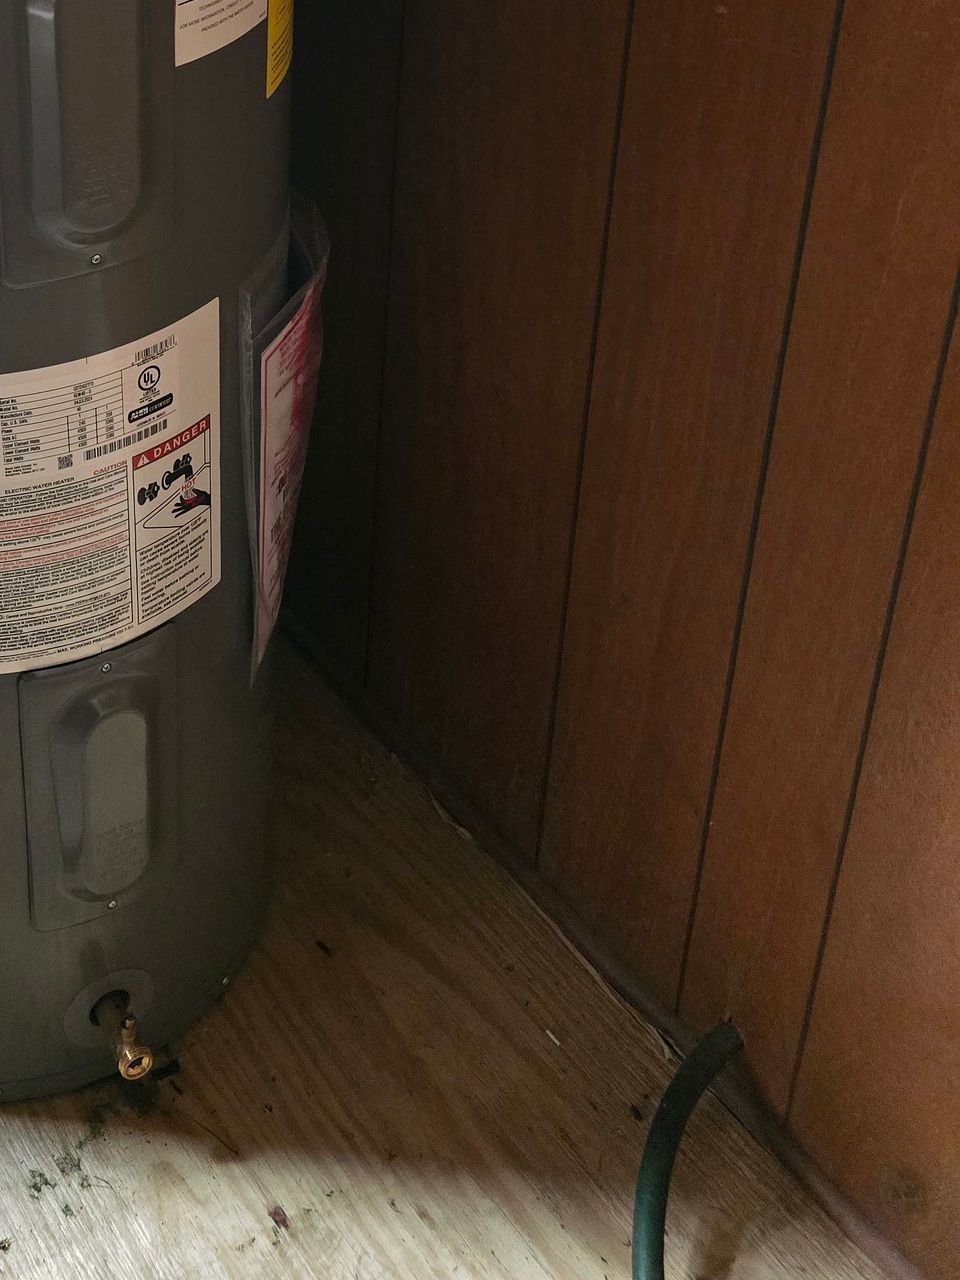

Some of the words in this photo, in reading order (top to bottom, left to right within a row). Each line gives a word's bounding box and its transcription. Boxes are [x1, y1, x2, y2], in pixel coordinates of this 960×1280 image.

[143, 372, 155, 384] UL
[154, 420, 207, 458] DANGER
[93, 460, 128, 476] CAUTION
[4, 486, 32, 494] ELECTRIC
[32, 482, 53, 490] WATER
[52, 476, 75, 487] HEATER
[181, 478, 196, 492] HOT
